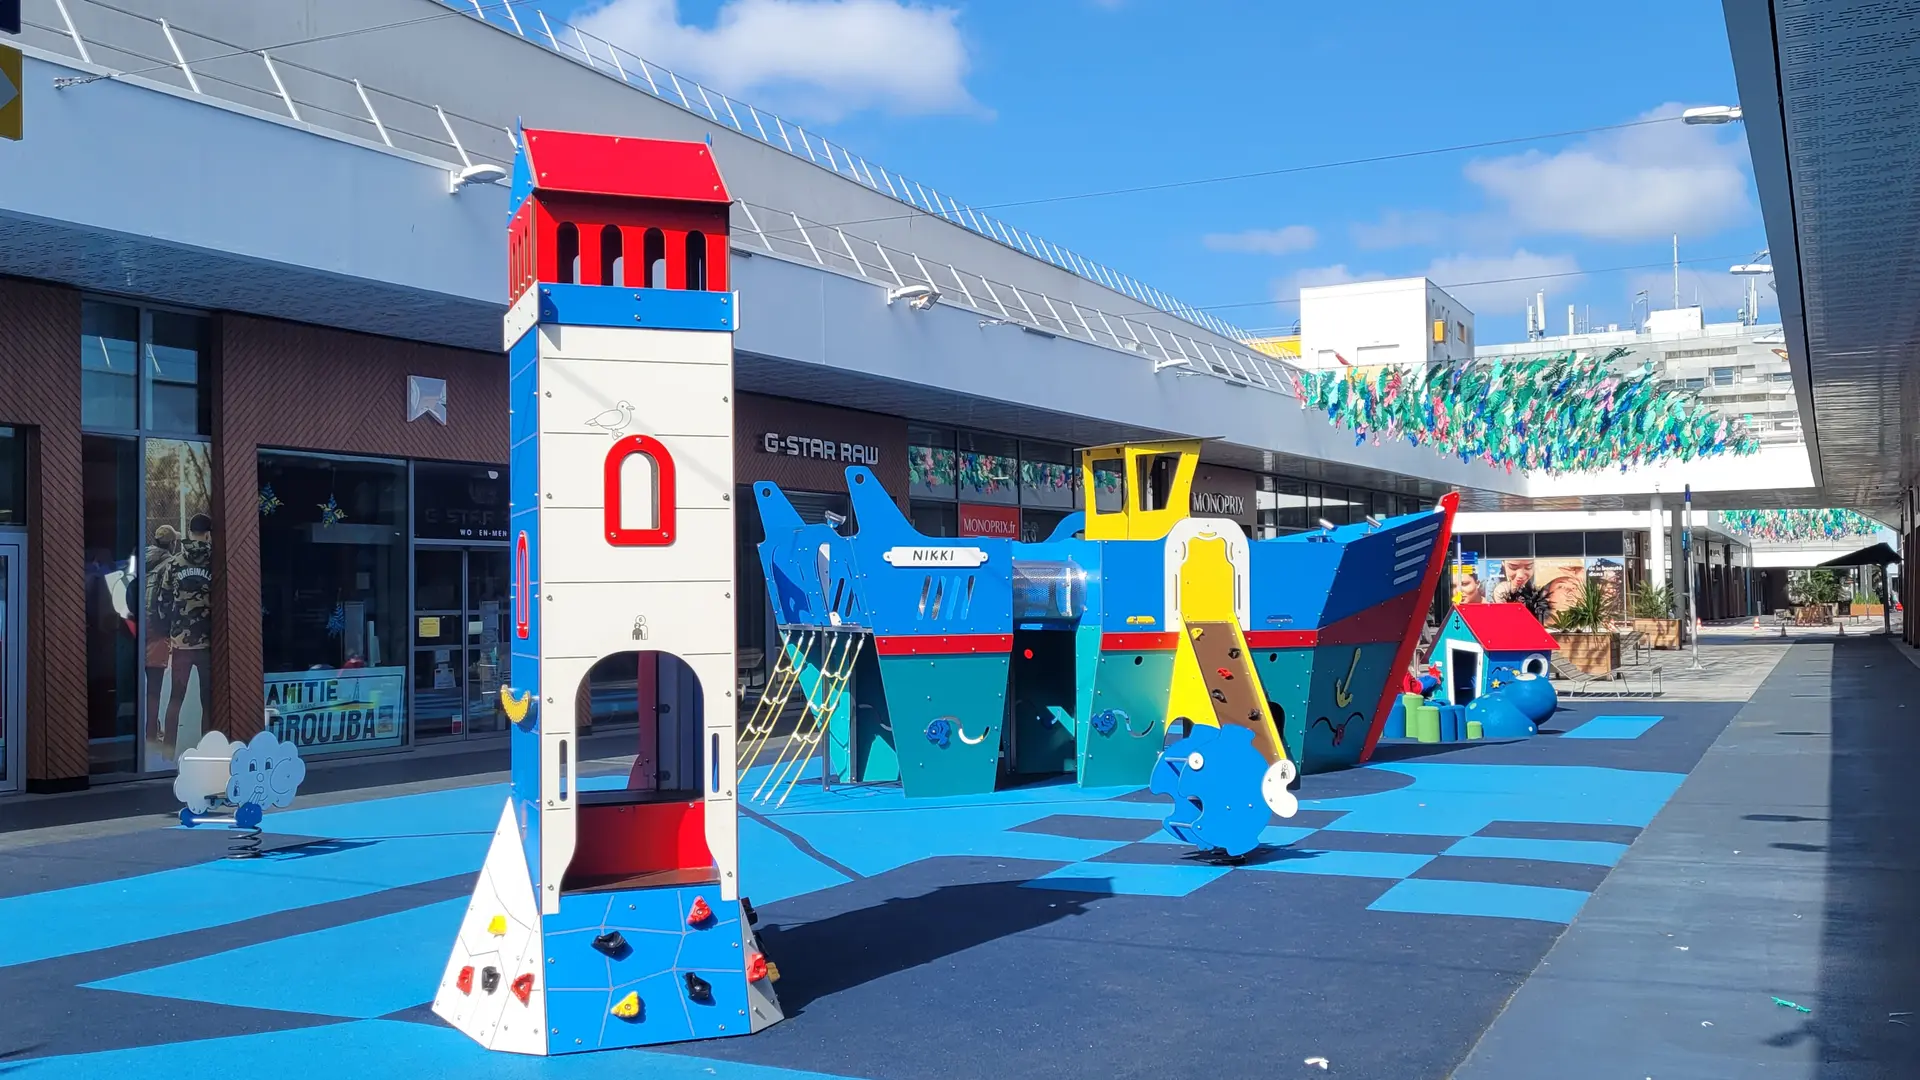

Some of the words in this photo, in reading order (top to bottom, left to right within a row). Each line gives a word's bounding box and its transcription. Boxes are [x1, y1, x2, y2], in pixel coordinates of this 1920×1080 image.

[764, 432, 836, 461] G-STAR
[840, 442, 879, 465] RAW
[1192, 491, 1245, 516] MONOPRIX
[963, 517, 1016, 534] MONOPRIX.fr
[912, 549, 955, 561] NIKKI
[266, 680, 339, 706] AMITIE
[268, 708, 376, 746] DROUJBA
